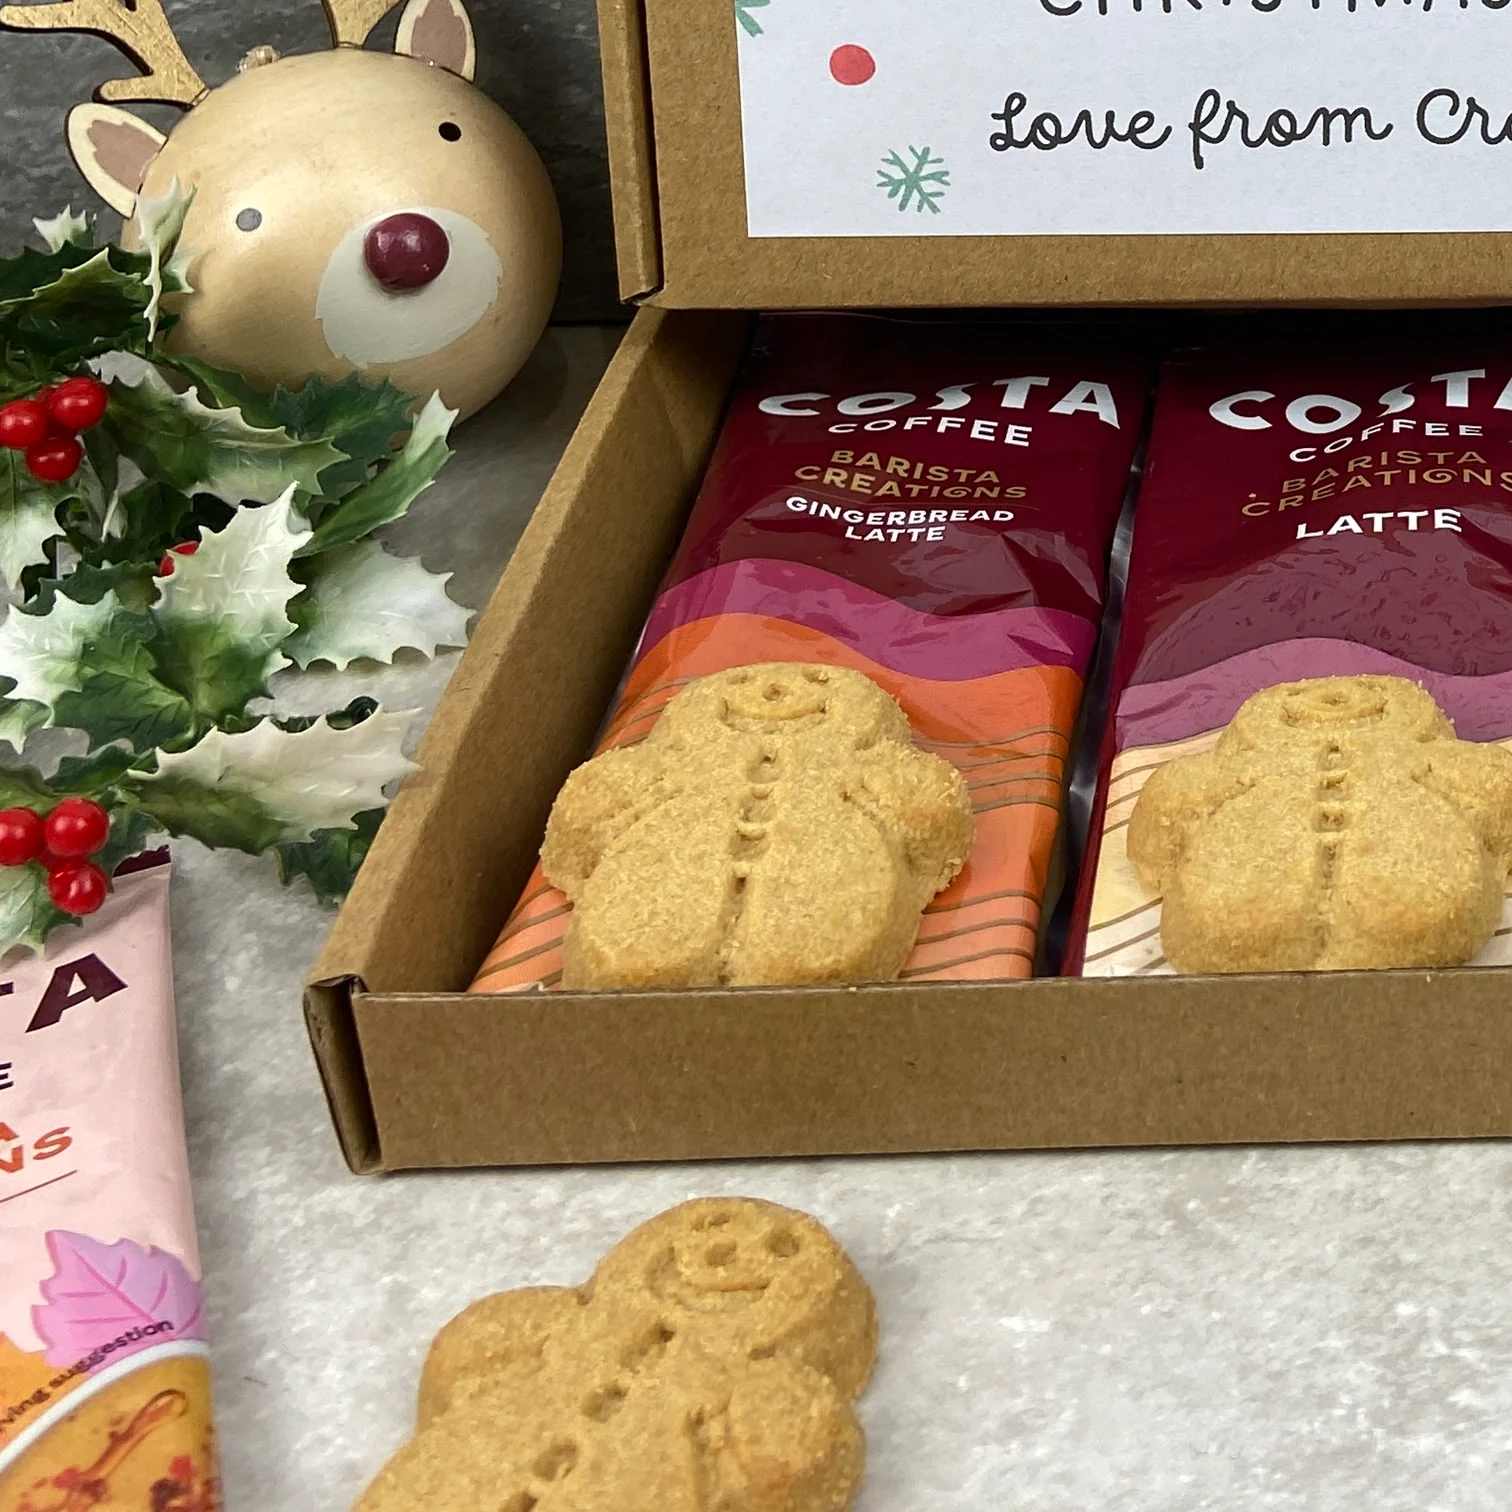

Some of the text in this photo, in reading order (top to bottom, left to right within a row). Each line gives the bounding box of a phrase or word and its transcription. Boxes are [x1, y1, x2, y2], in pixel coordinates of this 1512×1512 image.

[989, 91, 1173, 152] Love
[1187, 88, 1394, 170] from
[758, 375, 1121, 430] COSTA
[827, 415, 1033, 448] COFFEE
[1289, 418, 1484, 463] COFFEE
[794, 465, 1027, 500] CREATIONS
[830, 449, 1000, 484] BARISTA
[1281, 450, 1488, 495] BARISTA
[785, 496, 1015, 527] GINGERBREAD
[1295, 508, 1463, 539] LATTE
[844, 524, 946, 543] LATTE
[49, 1320, 175, 1389] suggestion
